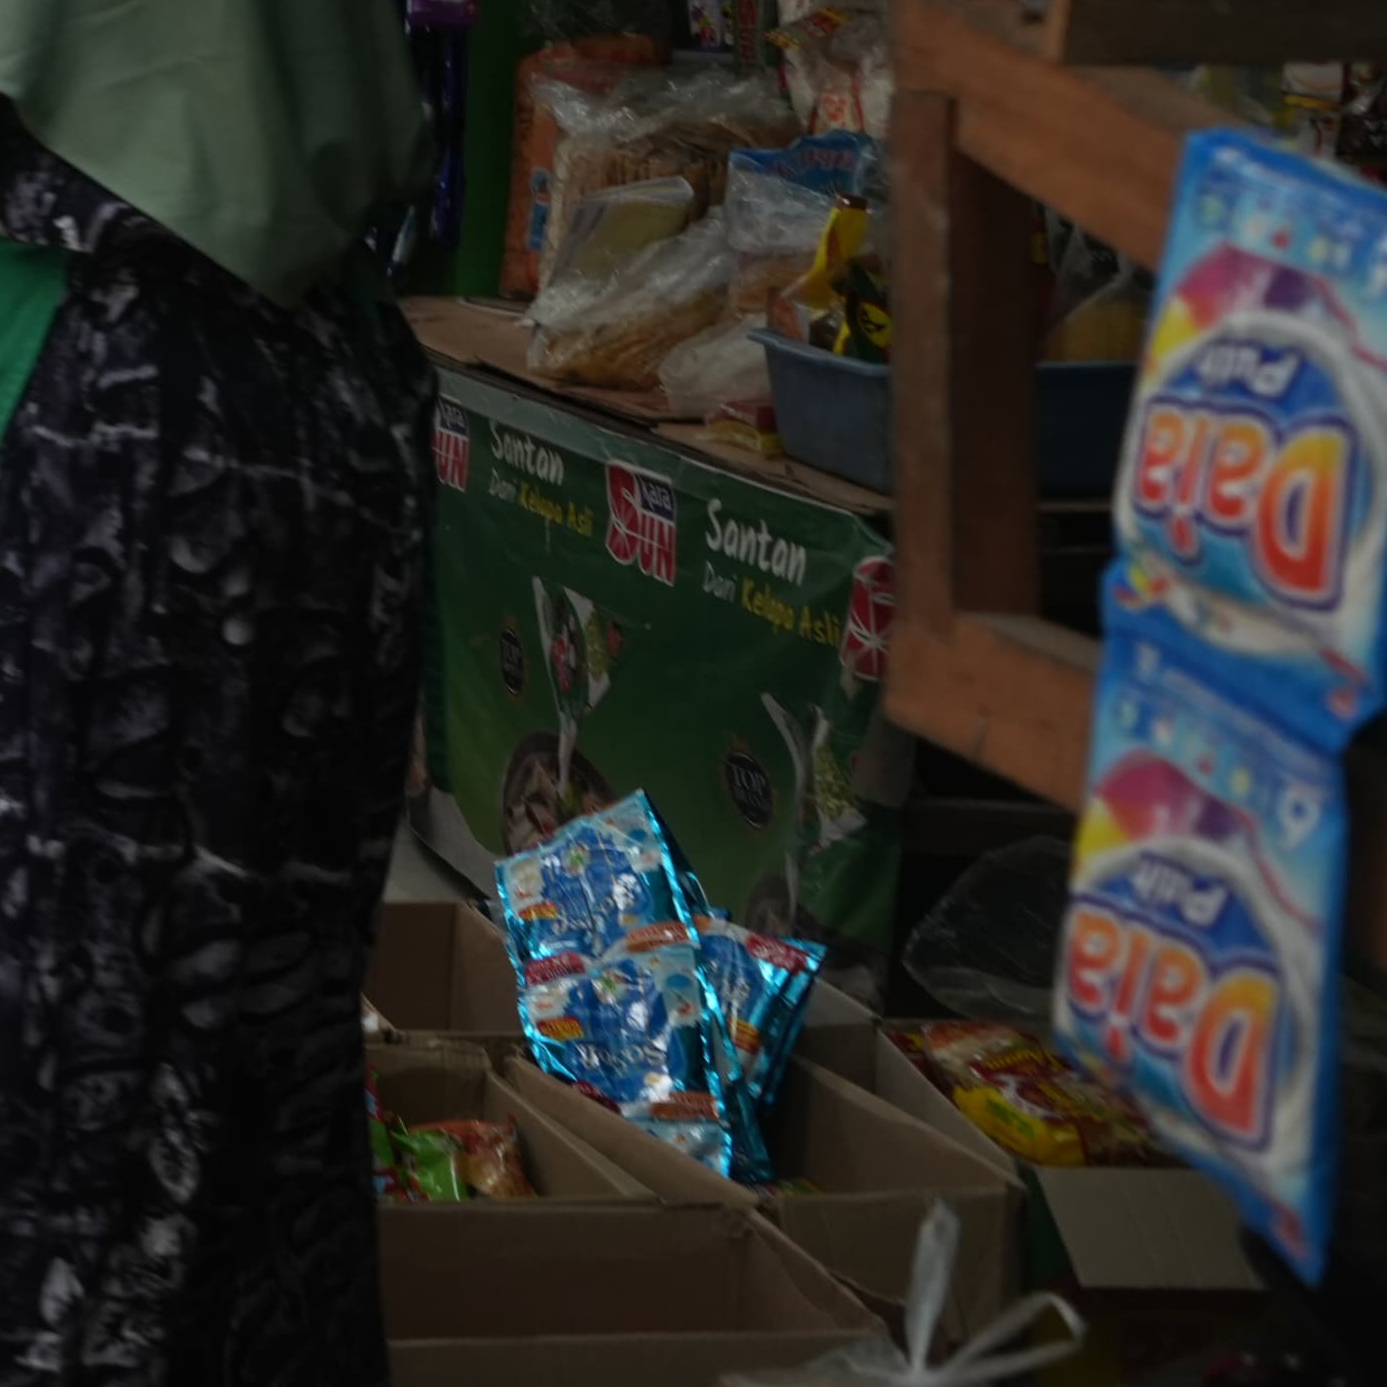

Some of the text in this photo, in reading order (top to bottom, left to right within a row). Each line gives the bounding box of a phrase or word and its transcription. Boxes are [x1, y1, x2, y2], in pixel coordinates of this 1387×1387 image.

[489, 420, 564, 487] Santan
[489, 470, 515, 498] Dari
[606, 460, 677, 586] SUN
[705, 498, 808, 585] Santan
[1133, 402, 1352, 605] Daia
[702, 561, 842, 648] Dari Kelapa Asli
[1067, 911, 1280, 1139] Daia
